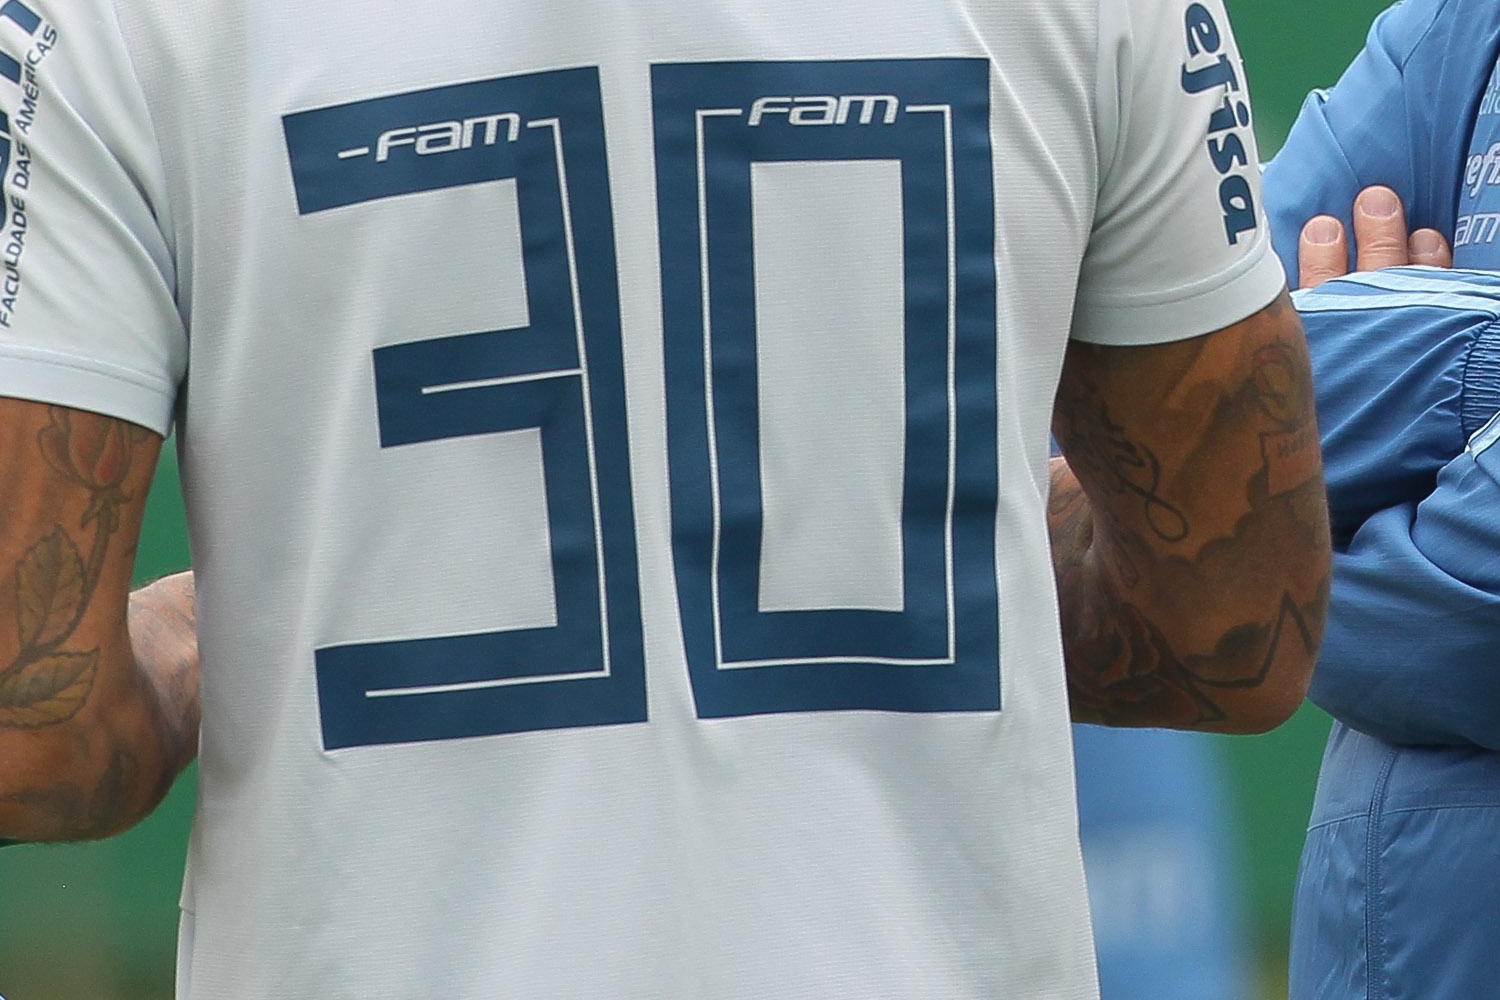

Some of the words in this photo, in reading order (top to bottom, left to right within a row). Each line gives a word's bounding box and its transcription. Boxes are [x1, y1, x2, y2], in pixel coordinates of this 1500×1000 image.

[16, 24, 58, 136] AMÉRICAS
[13, 141, 32, 191] DAS
[0, 196, 27, 328] FACULDADE
[282, 58, 1000, 751] 30
